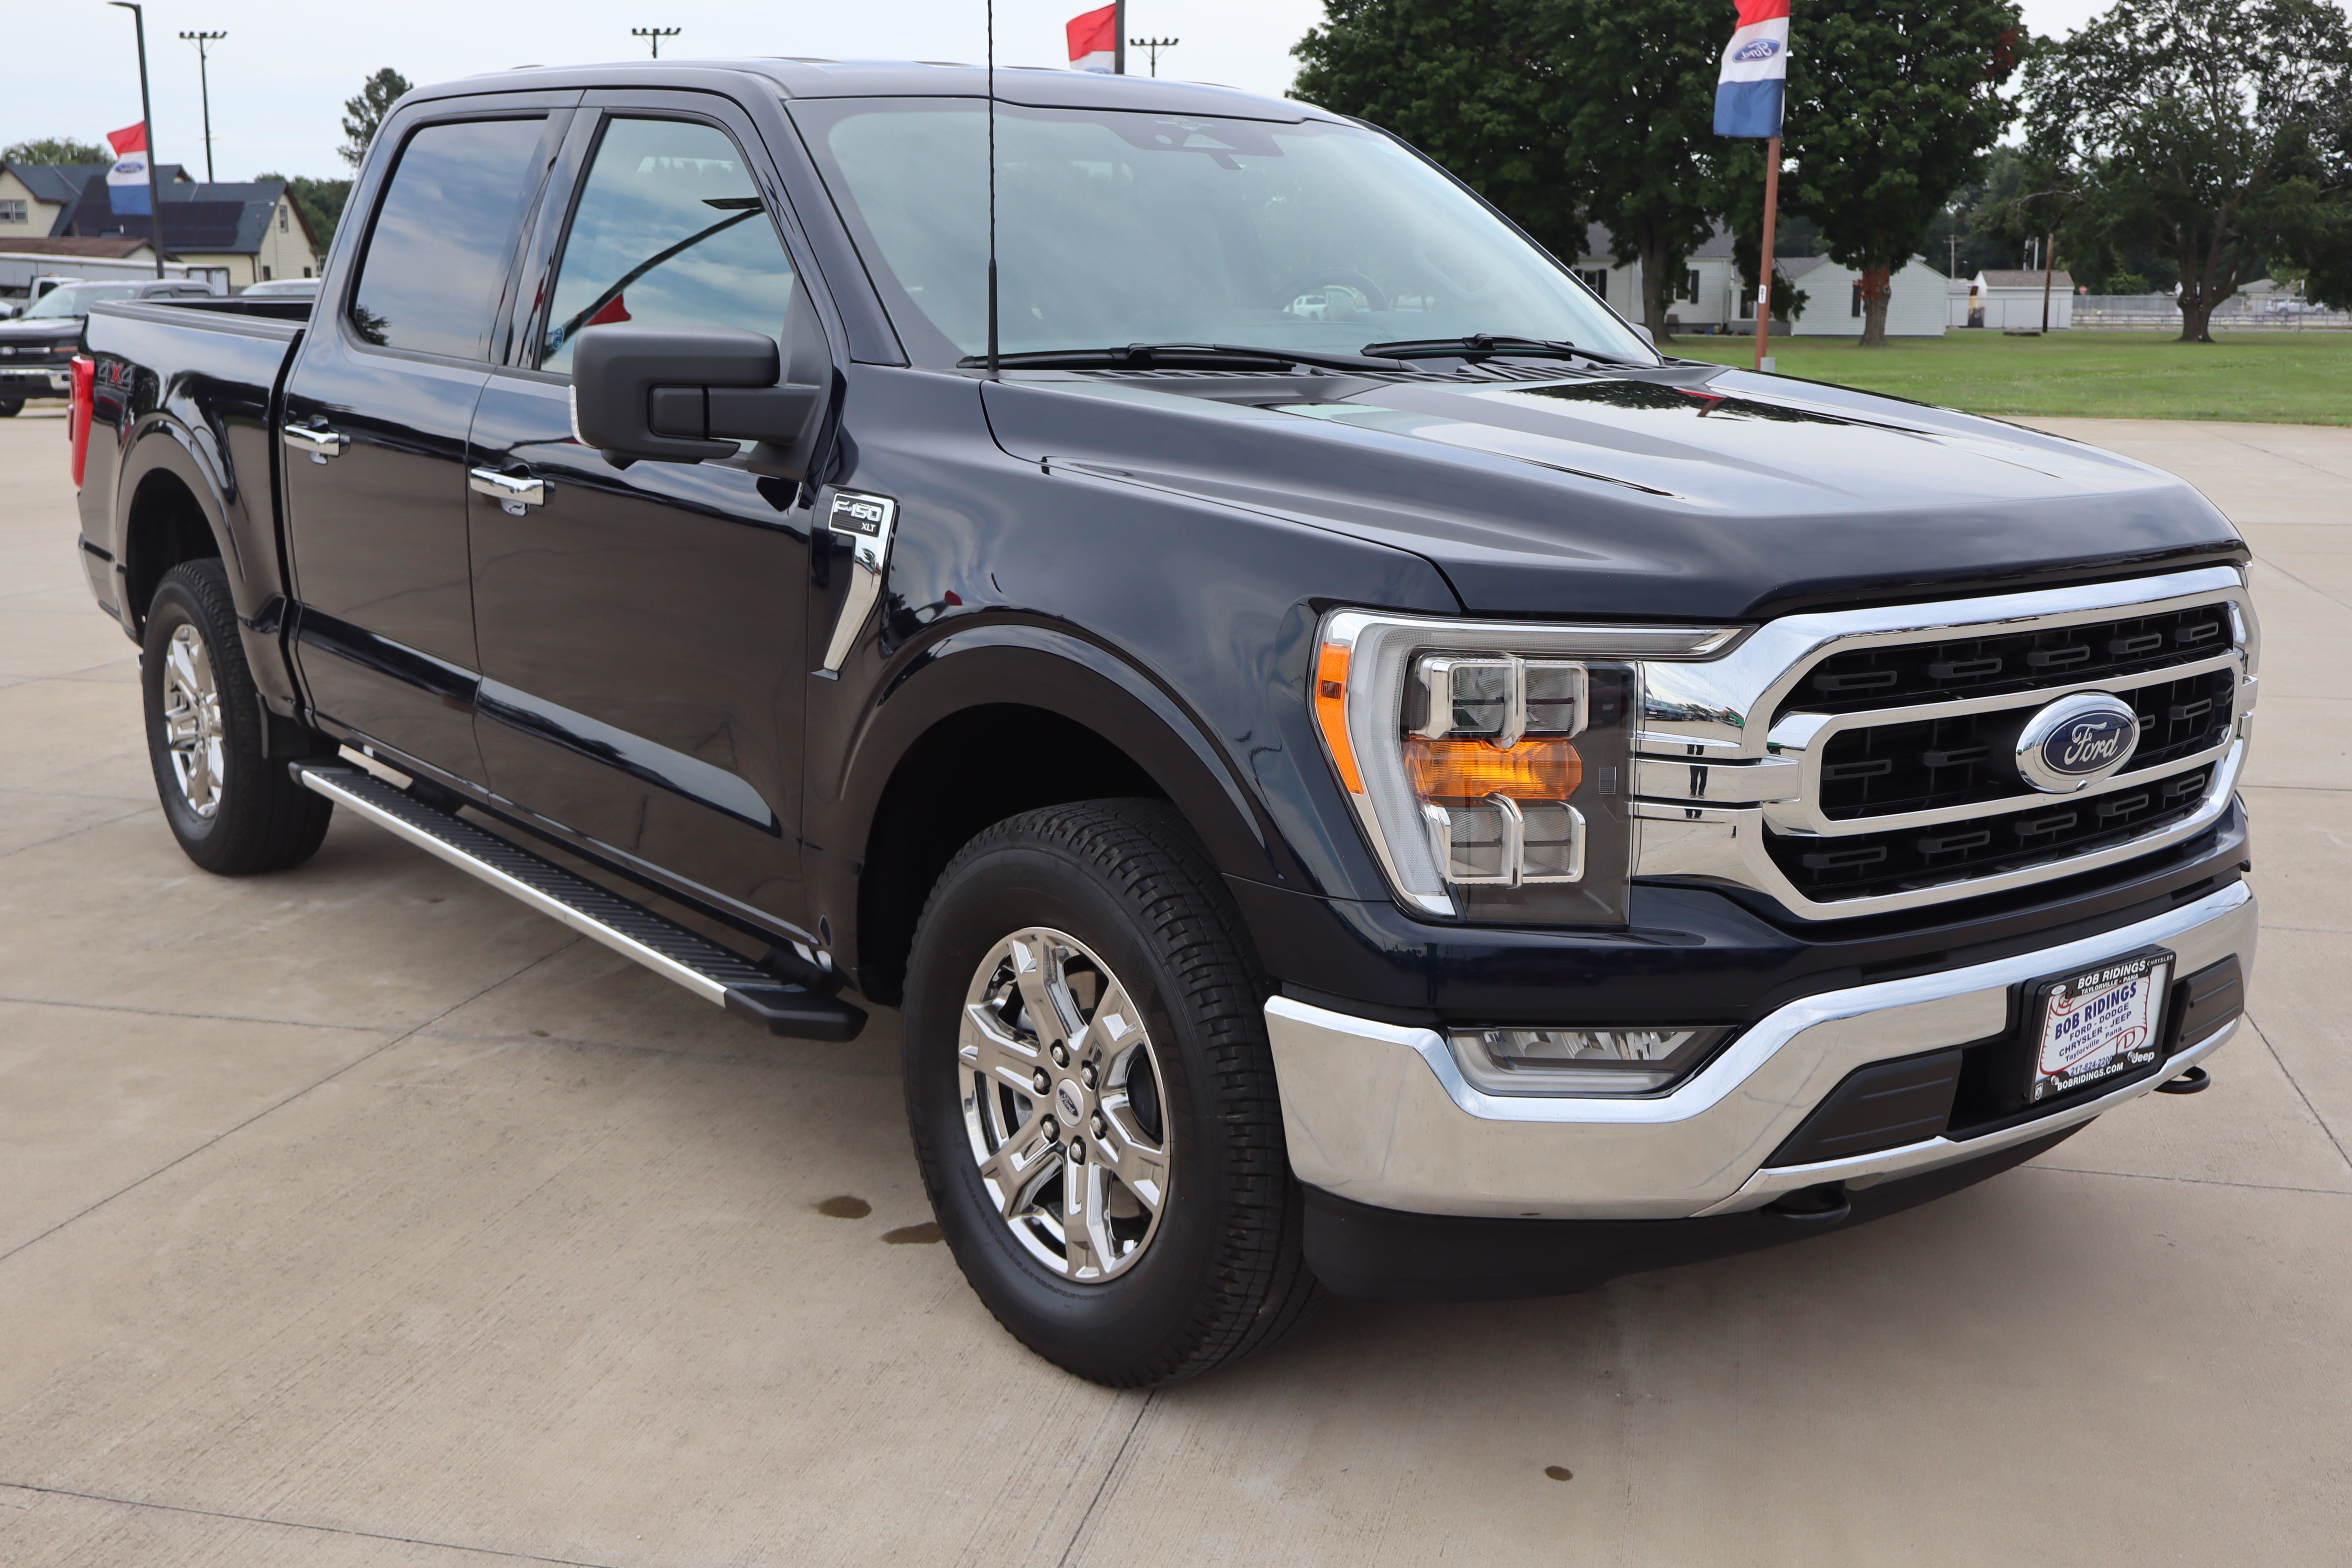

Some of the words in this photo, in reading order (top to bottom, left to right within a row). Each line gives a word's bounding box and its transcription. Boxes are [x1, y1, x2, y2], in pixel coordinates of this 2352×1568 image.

[833, 501, 882, 522] F-150
[861, 522, 876, 532] XLT
[2064, 722, 2120, 765] Ford
[2147, 955, 2173, 966] CHRYSLER
[2078, 973, 2100, 989] BOB
[2102, 960, 2146, 982] RIDINGS
[2081, 979, 2118, 995] TAYLORVILLE
[2123, 973, 2138, 983] PANA
[2055, 1012, 2080, 1041] BOB
[2085, 981, 2136, 1022] RIDINGS
[2070, 1022, 2092, 1041] FORD
[2100, 1002, 2129, 1024] DODGE
[2059, 1026, 2103, 1057] CHRYSLER
[2110, 1011, 2132, 1027] JEEP
[2065, 1039, 2099, 1062] Taylorville
[2105, 1027, 2122, 1039] Pana
[2071, 1055, 2113, 1076] 217-824-2200
[2131, 1051, 2155, 1064] Jeep
[2057, 1062, 2123, 1091] BOBRIDINGS.COM
[1061, 1094, 1075, 1114] Ford
